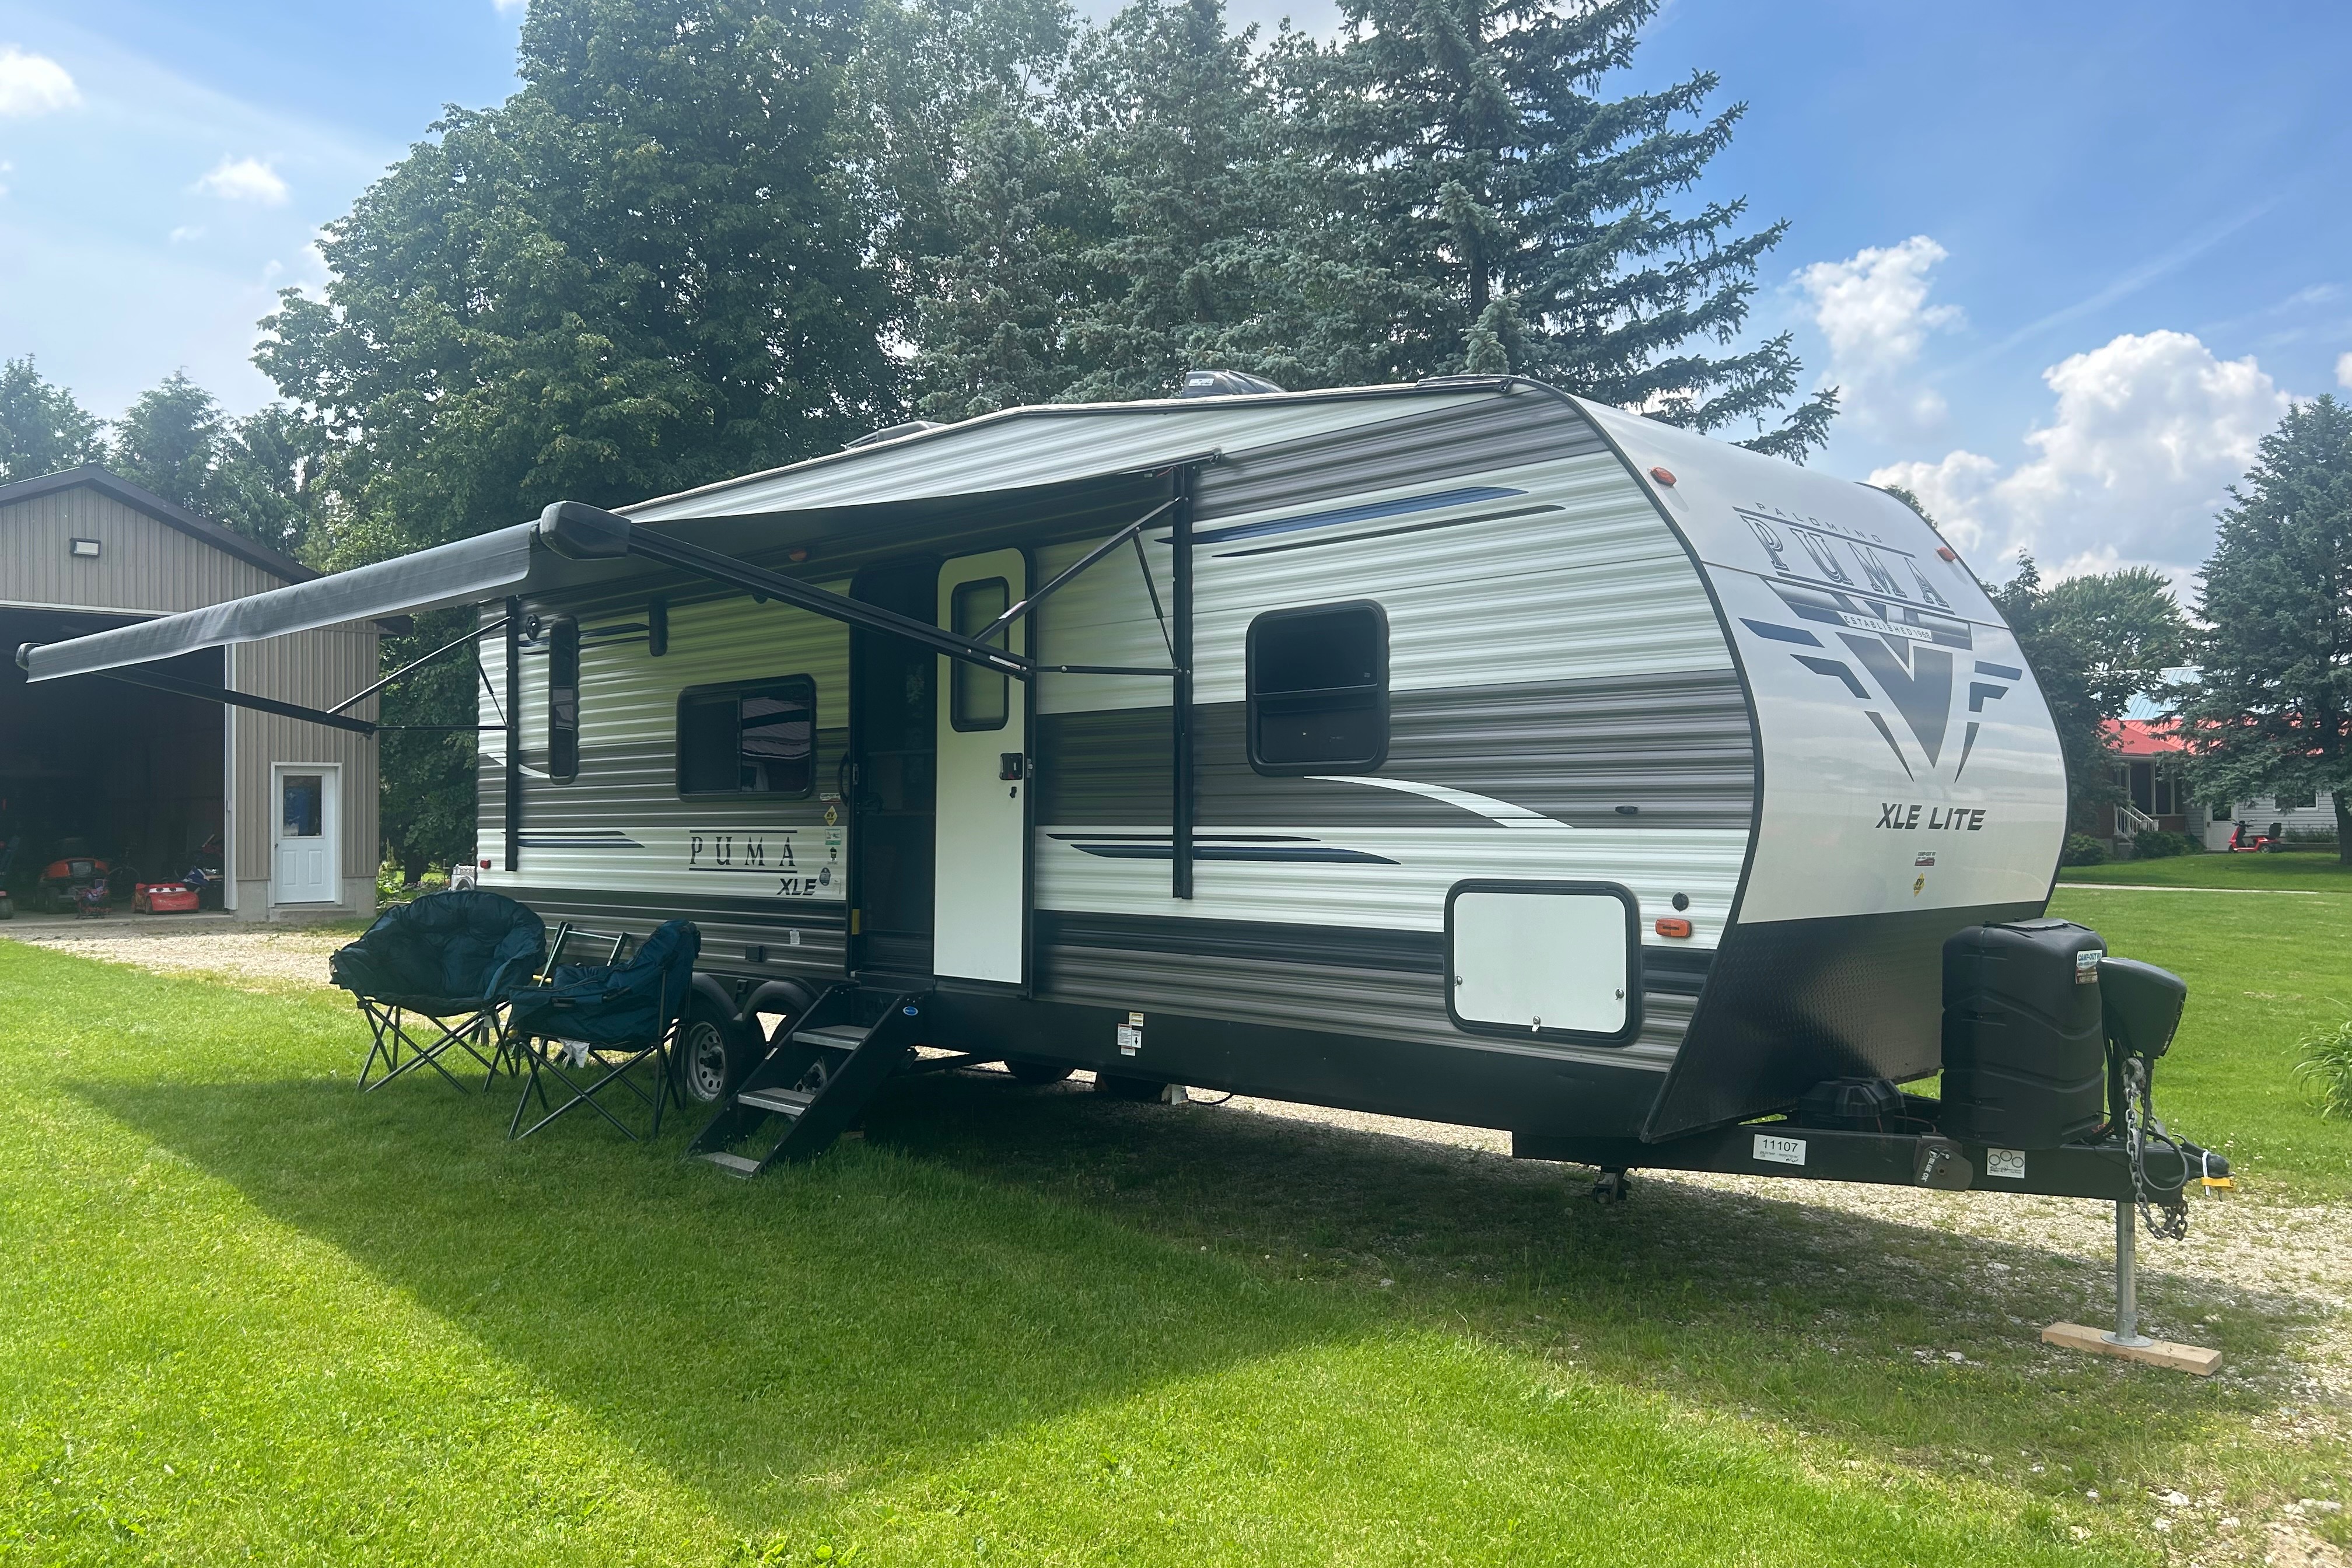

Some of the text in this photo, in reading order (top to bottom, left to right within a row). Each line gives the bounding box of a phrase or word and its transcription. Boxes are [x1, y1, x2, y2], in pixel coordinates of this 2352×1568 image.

[1755, 502, 1882, 542] PALOMINO
[1739, 513, 1950, 607] PUMA
[1843, 615, 1912, 635] ESTABLISHED
[1875, 803, 1986, 831] XLE LITE
[690, 836, 795, 867] PUMA
[776, 878, 817, 895] XLE
[1763, 1139, 1798, 1152] 11107
[1921, 1157, 1935, 1182] BLUE OX
